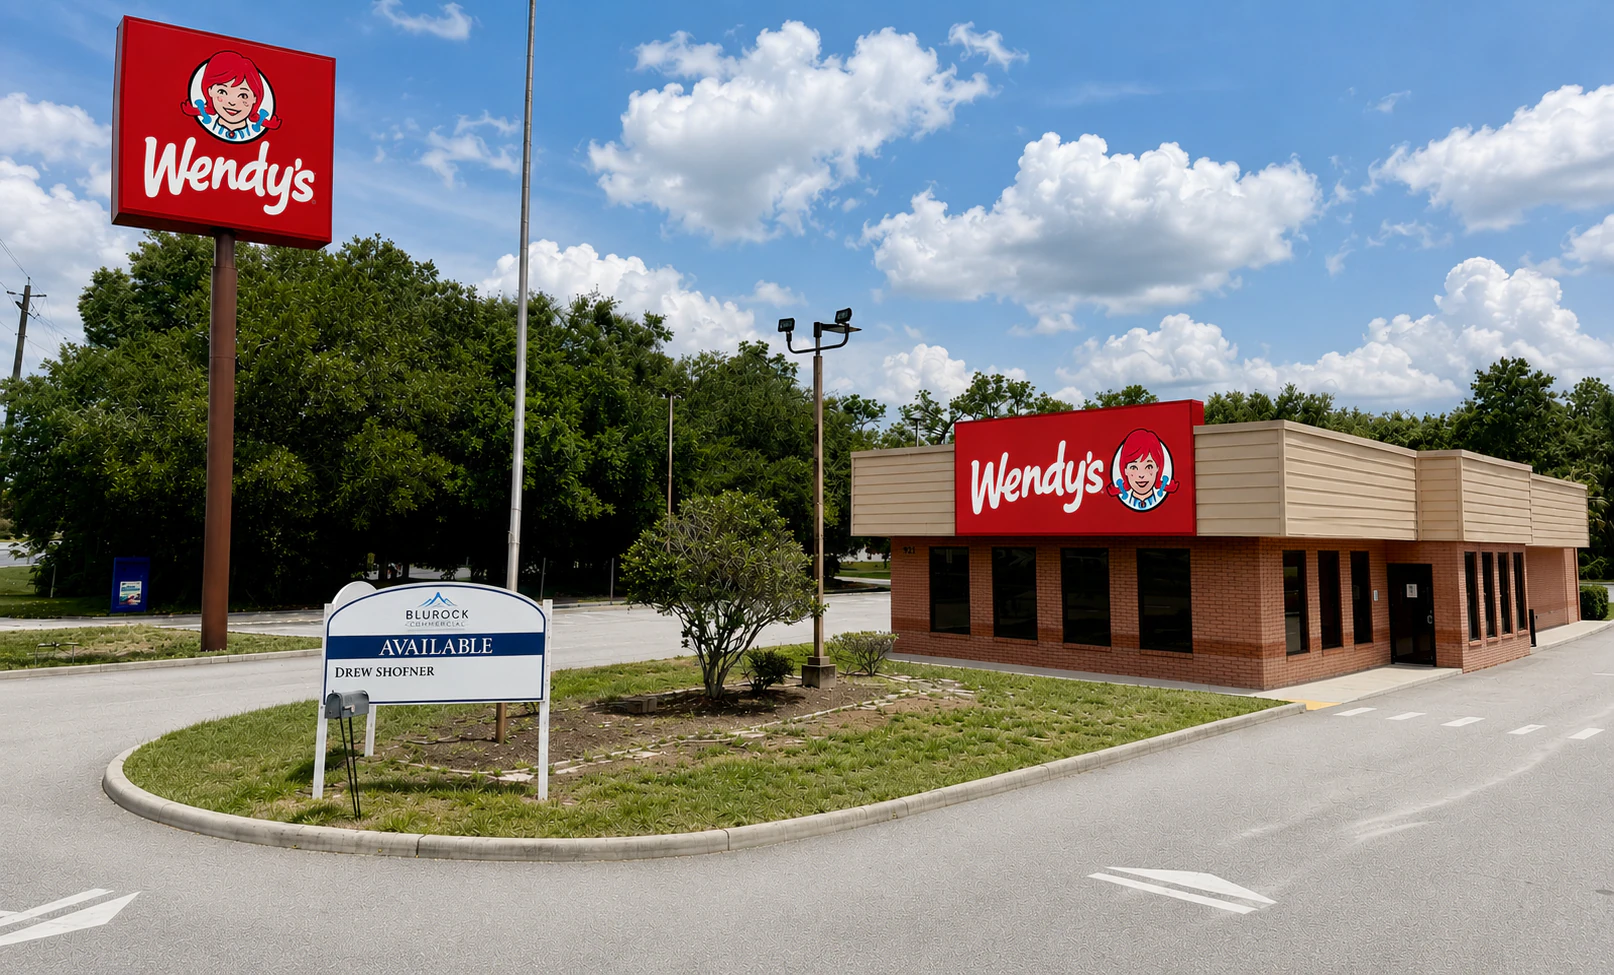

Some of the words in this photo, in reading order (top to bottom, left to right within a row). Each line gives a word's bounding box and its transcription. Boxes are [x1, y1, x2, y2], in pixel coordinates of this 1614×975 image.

[144, 136, 315, 216] Wendy's
[971, 440, 1104, 515] Wendy's
[405, 609, 469, 620] BLUROCK
[378, 637, 493, 656] AVAILABLE
[335, 667, 373, 678] DREW
[376, 666, 435, 677] SHOFNER
